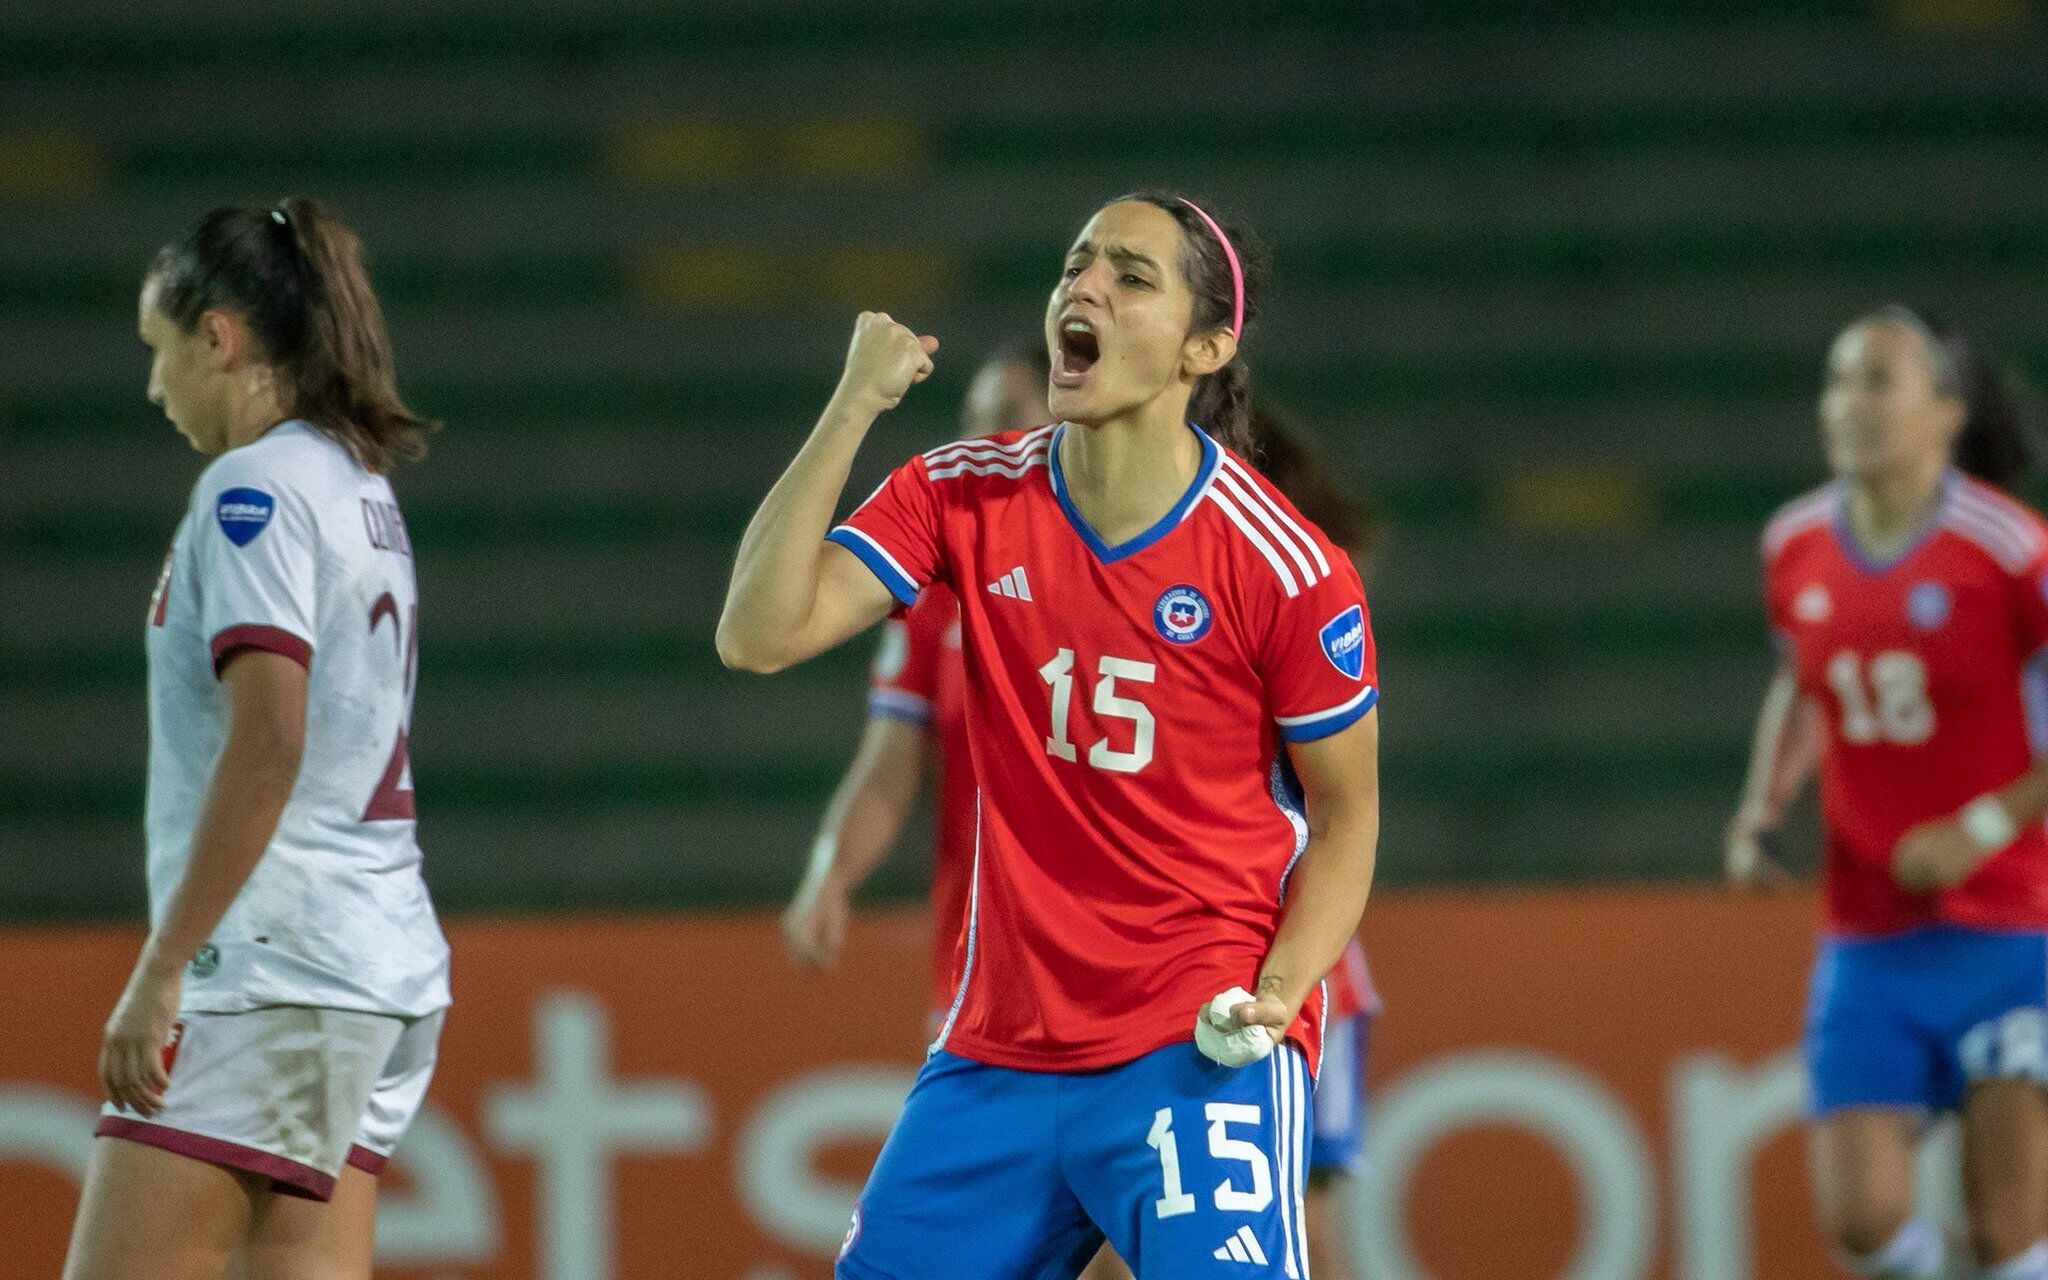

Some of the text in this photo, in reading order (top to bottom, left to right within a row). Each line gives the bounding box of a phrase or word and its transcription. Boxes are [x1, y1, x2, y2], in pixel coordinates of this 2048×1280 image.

[1038, 647, 1156, 773] 15
[1827, 650, 1938, 744] 18
[1146, 1102, 1273, 1219] 15
